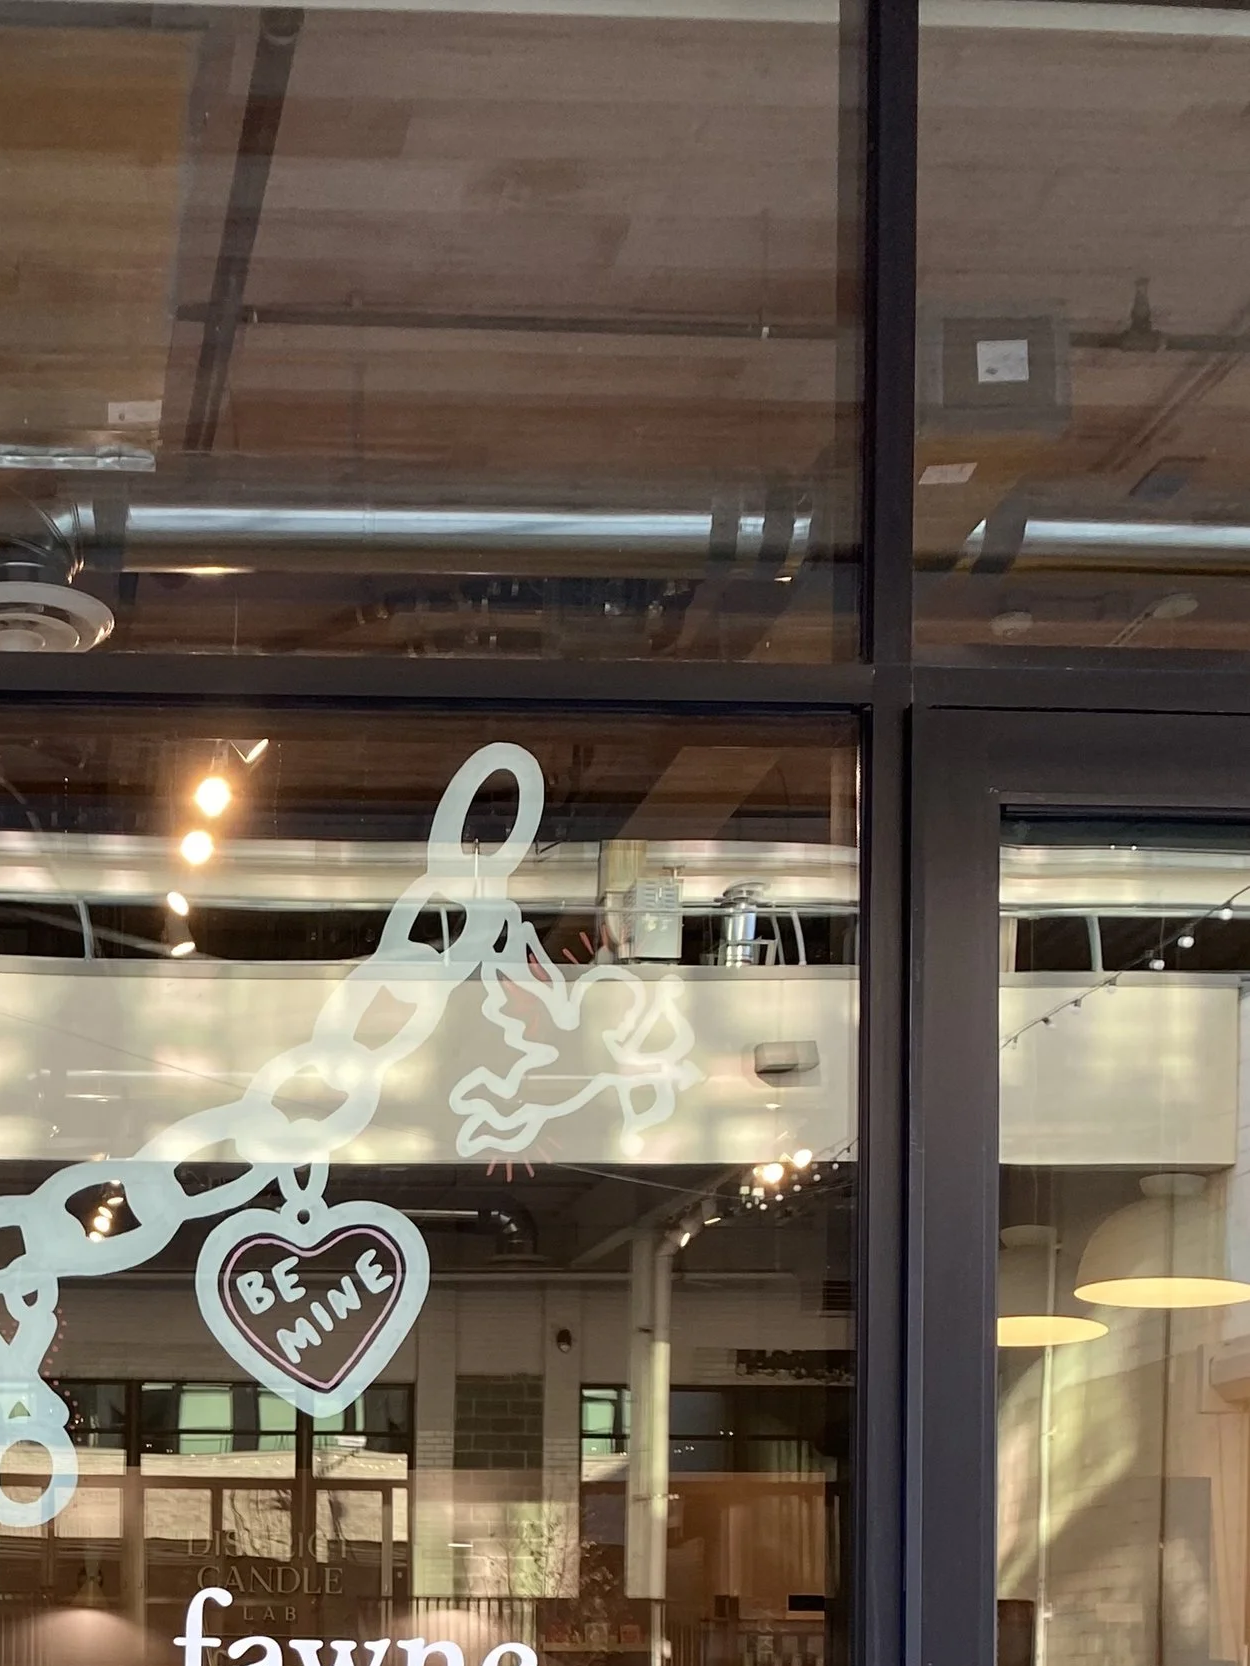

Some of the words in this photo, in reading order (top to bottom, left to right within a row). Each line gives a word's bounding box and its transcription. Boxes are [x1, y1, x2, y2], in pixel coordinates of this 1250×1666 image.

[236, 1256, 306, 1315] BE
[277, 1249, 394, 1364] MINE
[187, 1529, 350, 1559] DISICT
[197, 1565, 343, 1595] CANDLE
[243, 1606, 296, 1621] LAB
